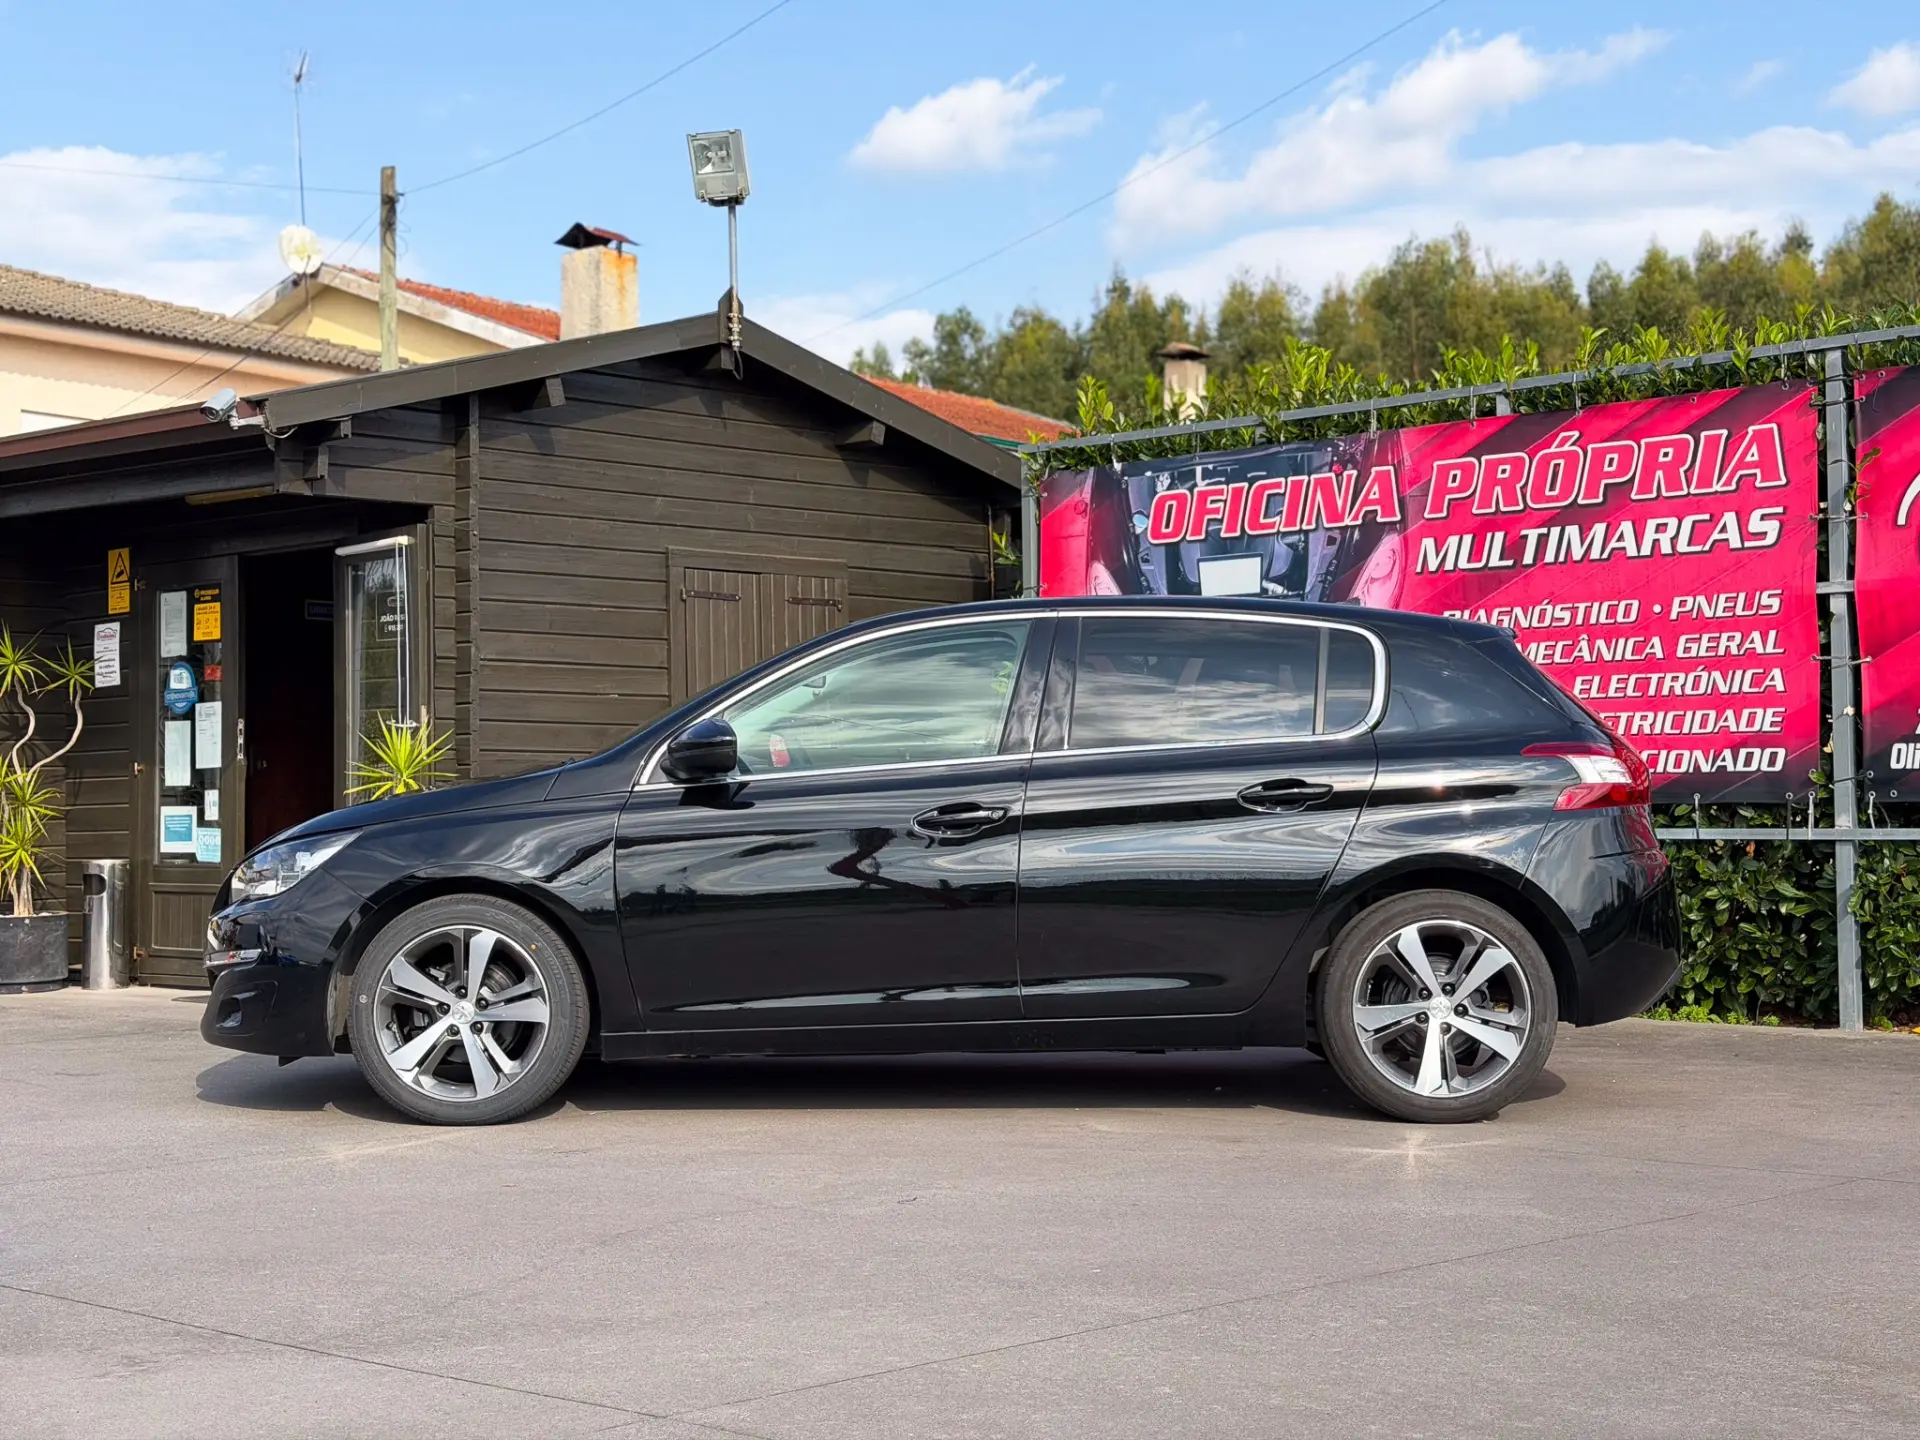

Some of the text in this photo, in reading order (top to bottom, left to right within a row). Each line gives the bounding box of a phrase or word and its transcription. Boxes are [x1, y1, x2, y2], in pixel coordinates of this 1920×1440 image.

[1147, 422, 1787, 545] OFICINA PRÓPRIA
[1415, 506, 1784, 574] MULTIMARCAS
[1670, 589, 1782, 621] PNEUS
[1676, 630, 1785, 658] GERAL
[1573, 666, 1786, 699] ELECTRÓNICA
